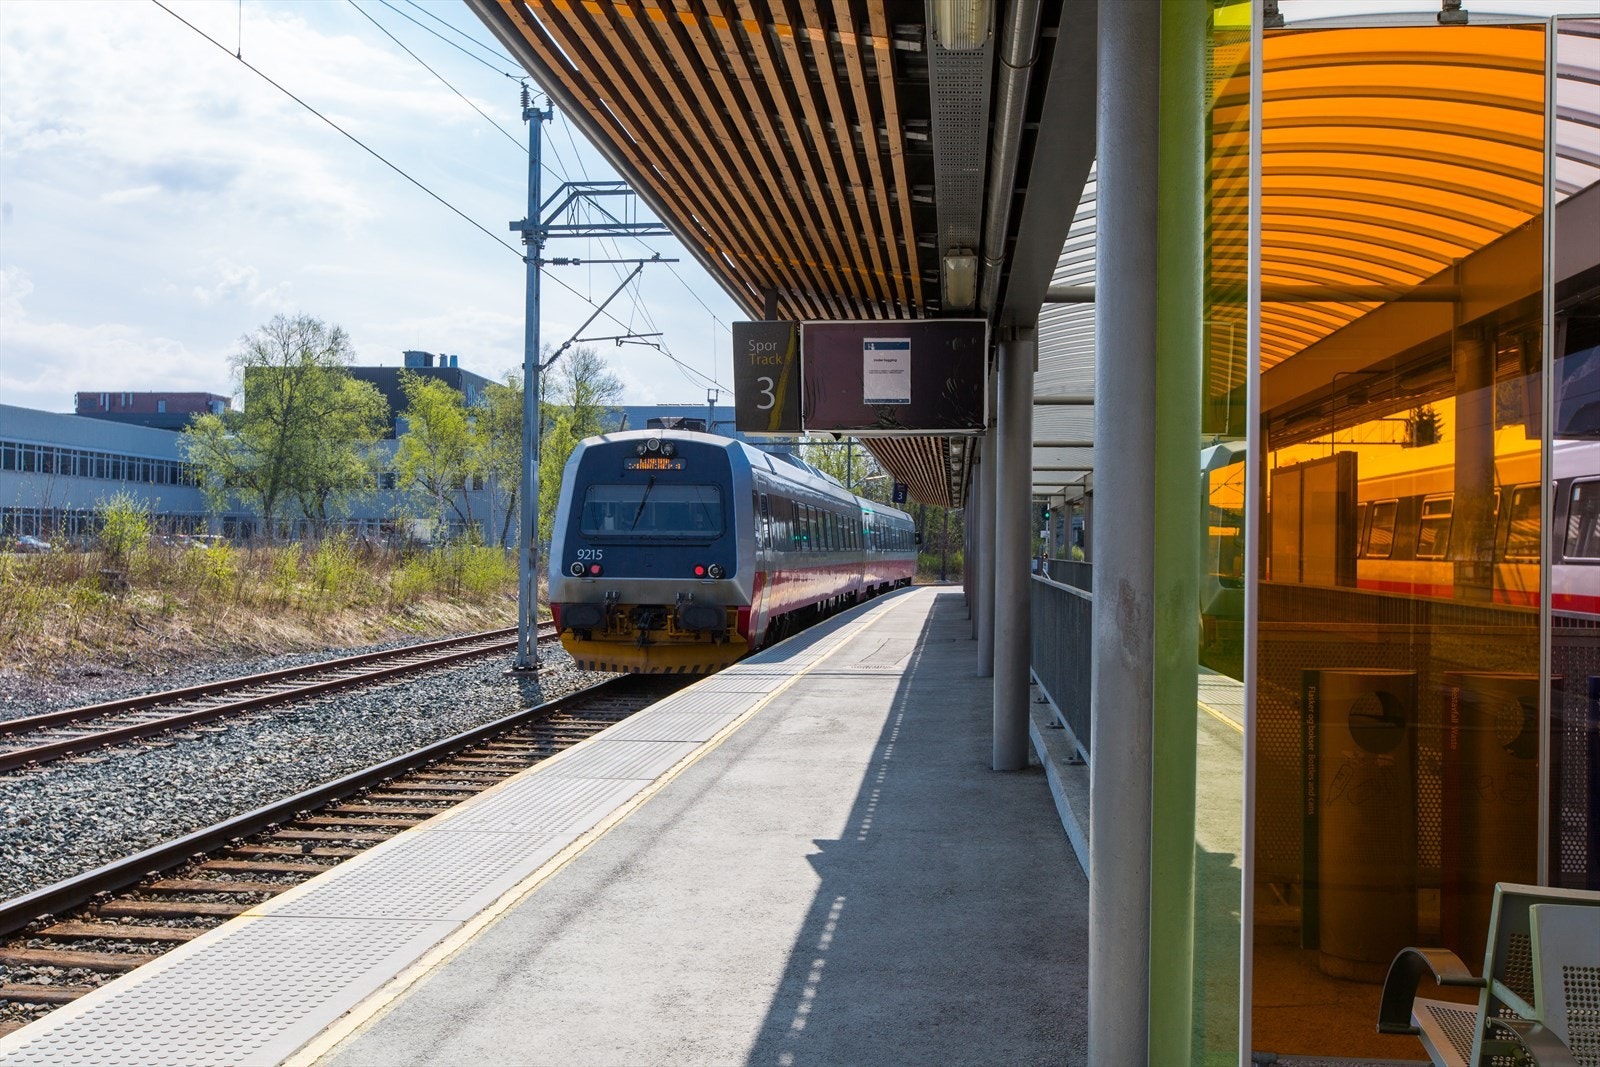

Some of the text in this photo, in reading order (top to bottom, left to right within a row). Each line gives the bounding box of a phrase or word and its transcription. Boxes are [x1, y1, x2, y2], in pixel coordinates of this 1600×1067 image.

[748, 339, 778, 354] Spor
[748, 352, 783, 365] Track
[756, 376, 776, 410] 3
[897, 491, 903, 500] 3
[577, 548, 603, 560] 9215
[1307, 686, 1316, 712] Flasker
[1306, 713, 1315, 724] og
[1450, 686, 1460, 750] Restavfall Waste
[1307, 725, 1316, 751] bokser
[1307, 754, 1316, 780] Bottles
[1307, 781, 1316, 796] and
